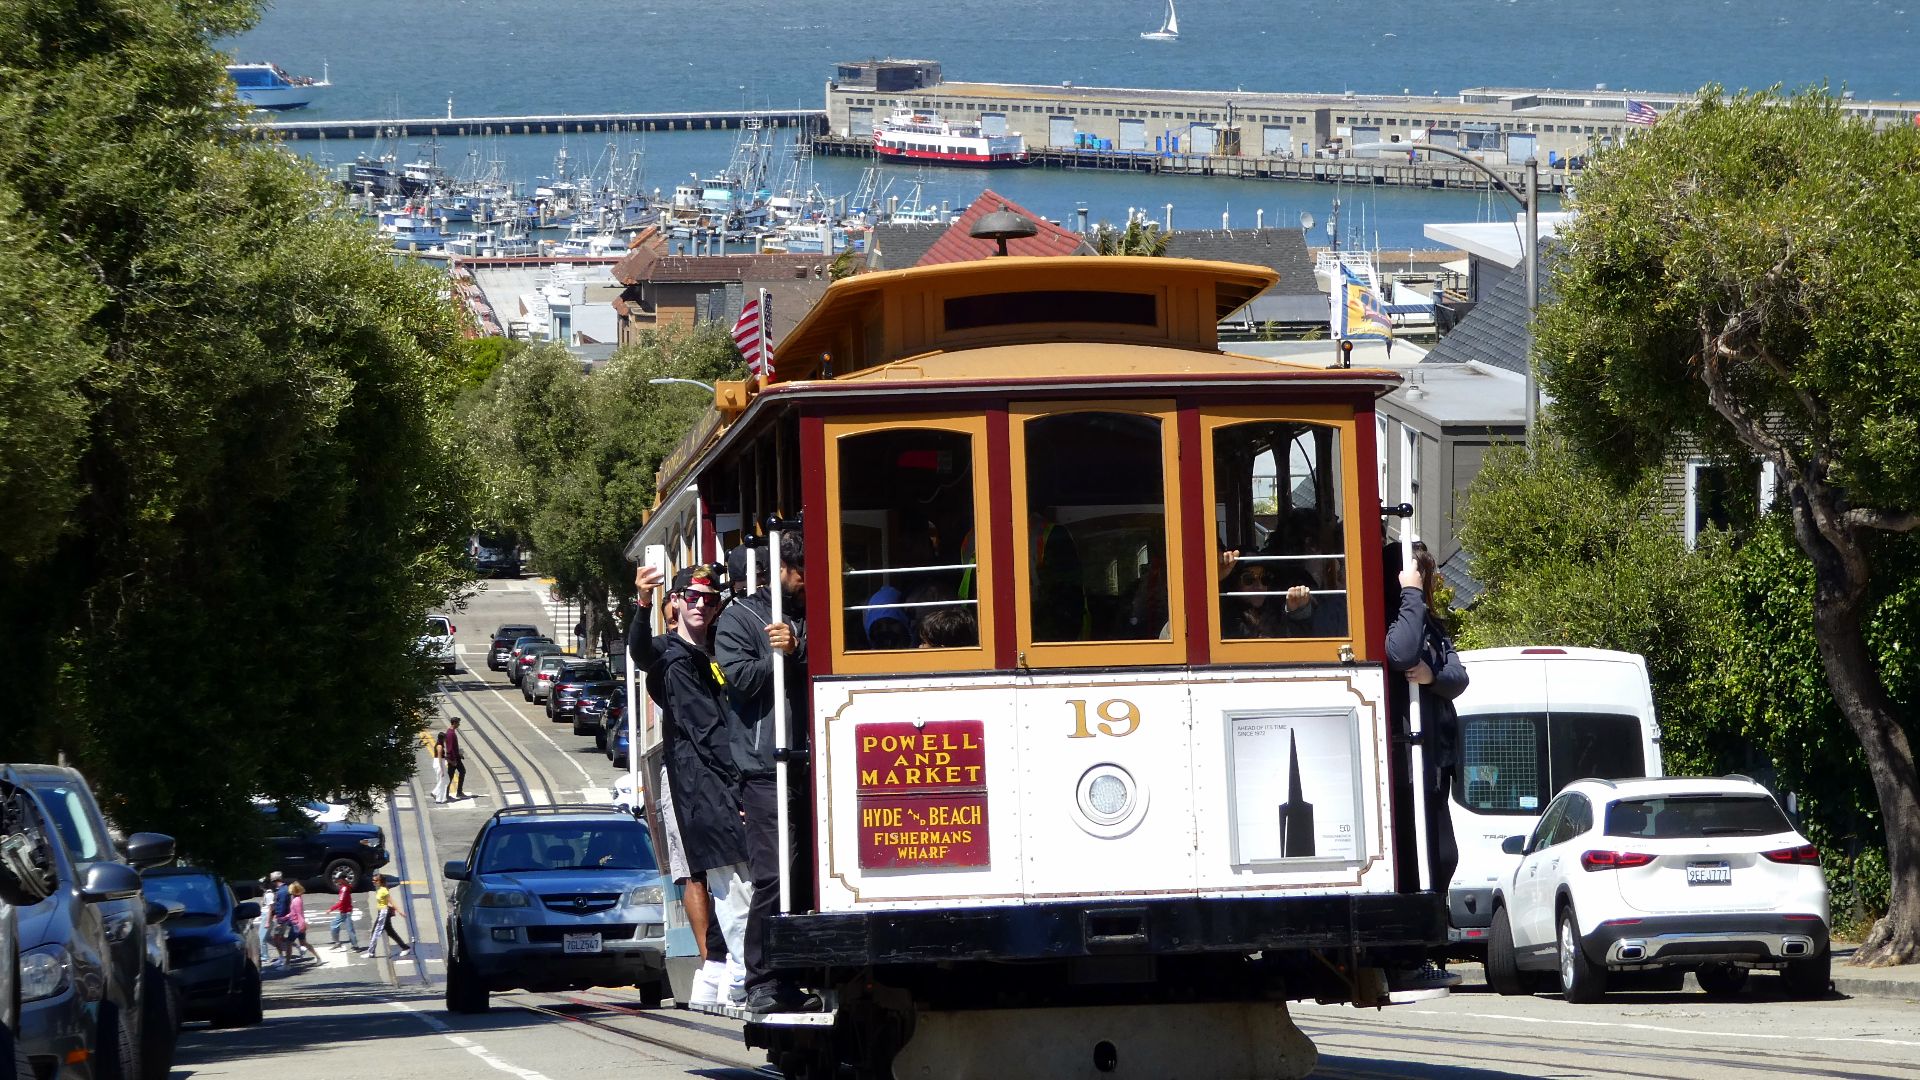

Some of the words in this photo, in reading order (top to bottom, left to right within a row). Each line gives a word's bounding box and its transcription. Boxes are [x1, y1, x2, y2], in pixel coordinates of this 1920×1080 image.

[1065, 699, 1140, 738] 19
[863, 733, 978, 753] POWELL
[894, 752, 951, 767] AND
[861, 765, 981, 786] MARKET
[863, 808, 902, 828] HYDE
[907, 808, 927, 826] AND
[929, 805, 981, 826] BEACH
[874, 830, 972, 846] FISHERMANS
[898, 846, 949, 860] WHARF
